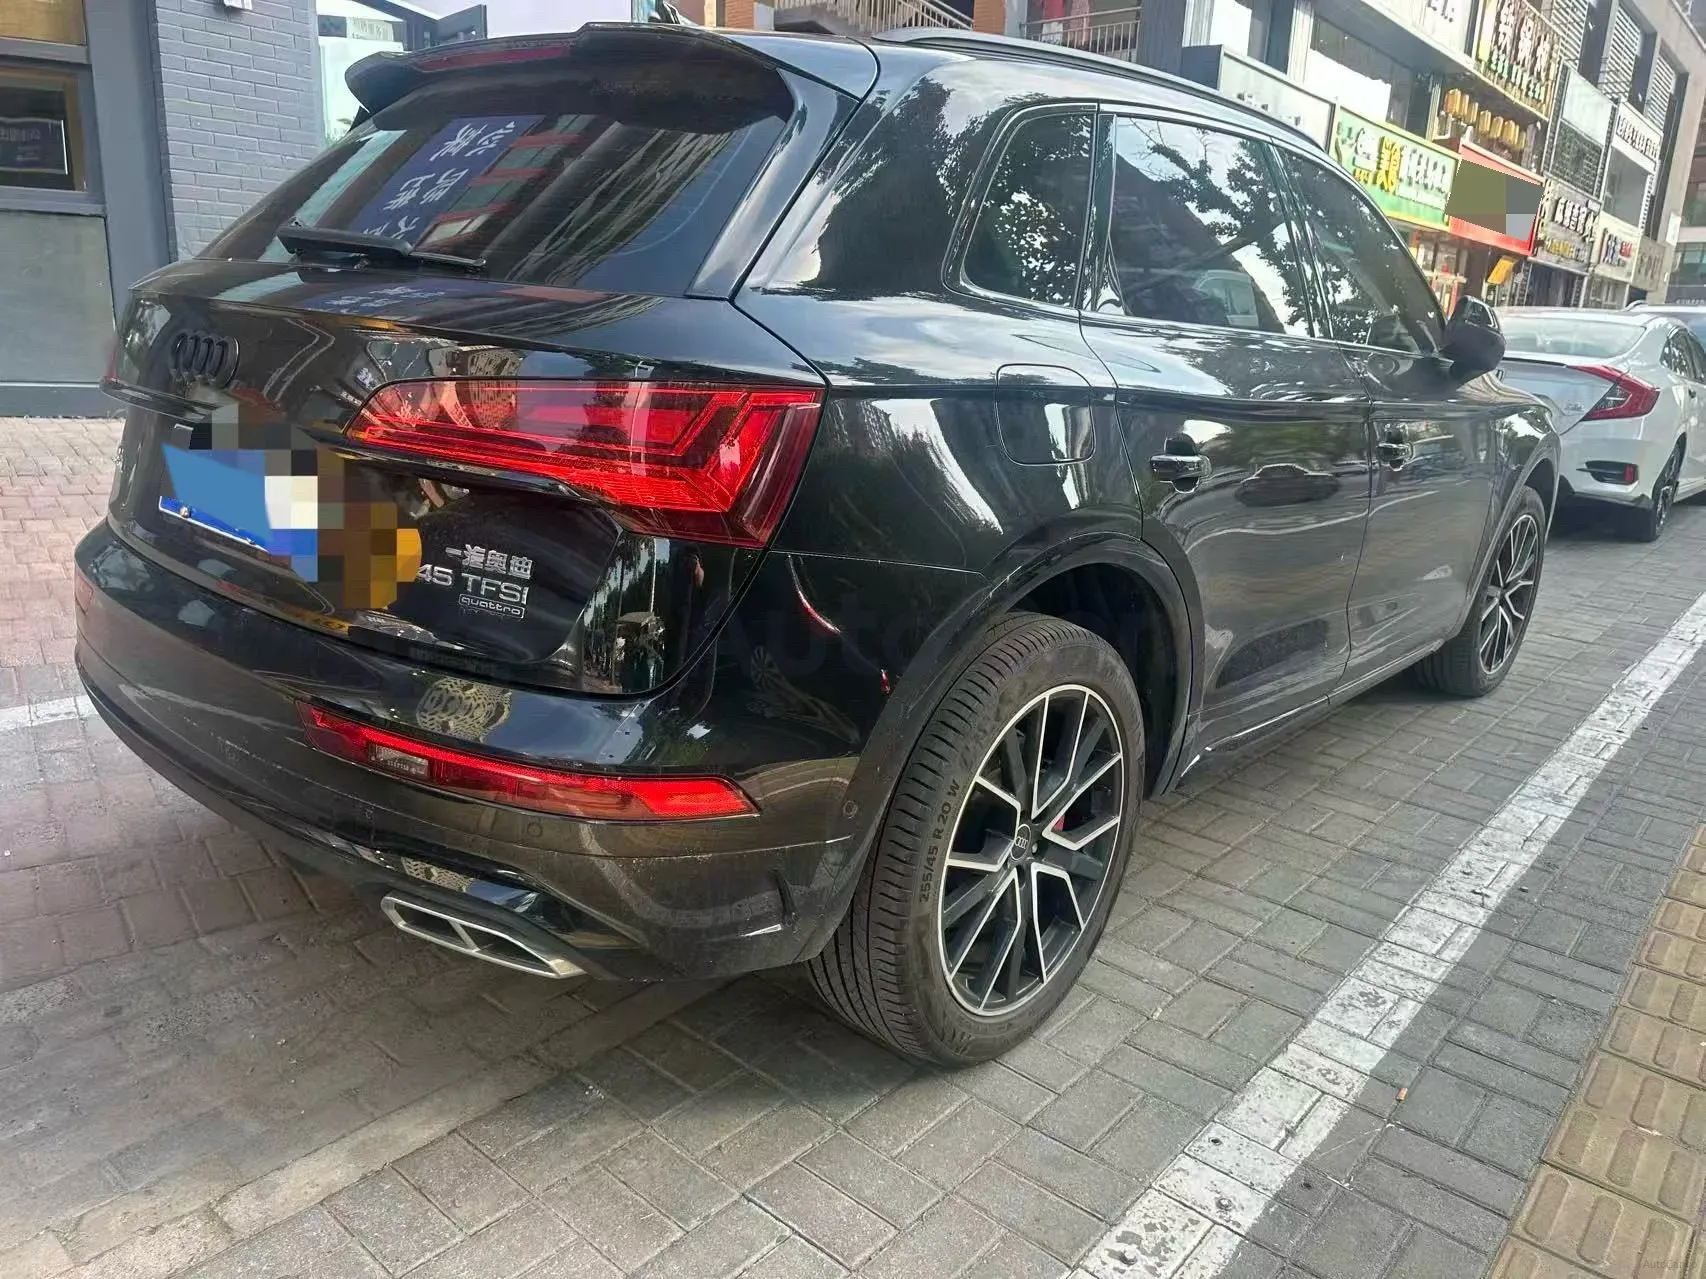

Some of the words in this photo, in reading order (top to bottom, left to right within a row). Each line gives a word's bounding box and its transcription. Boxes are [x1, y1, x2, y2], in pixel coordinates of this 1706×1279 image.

[418, 564, 453, 587] 45
[462, 573, 529, 605] TFSI
[460, 595, 523, 617] quattro
[920, 845, 939, 903] 255/45
